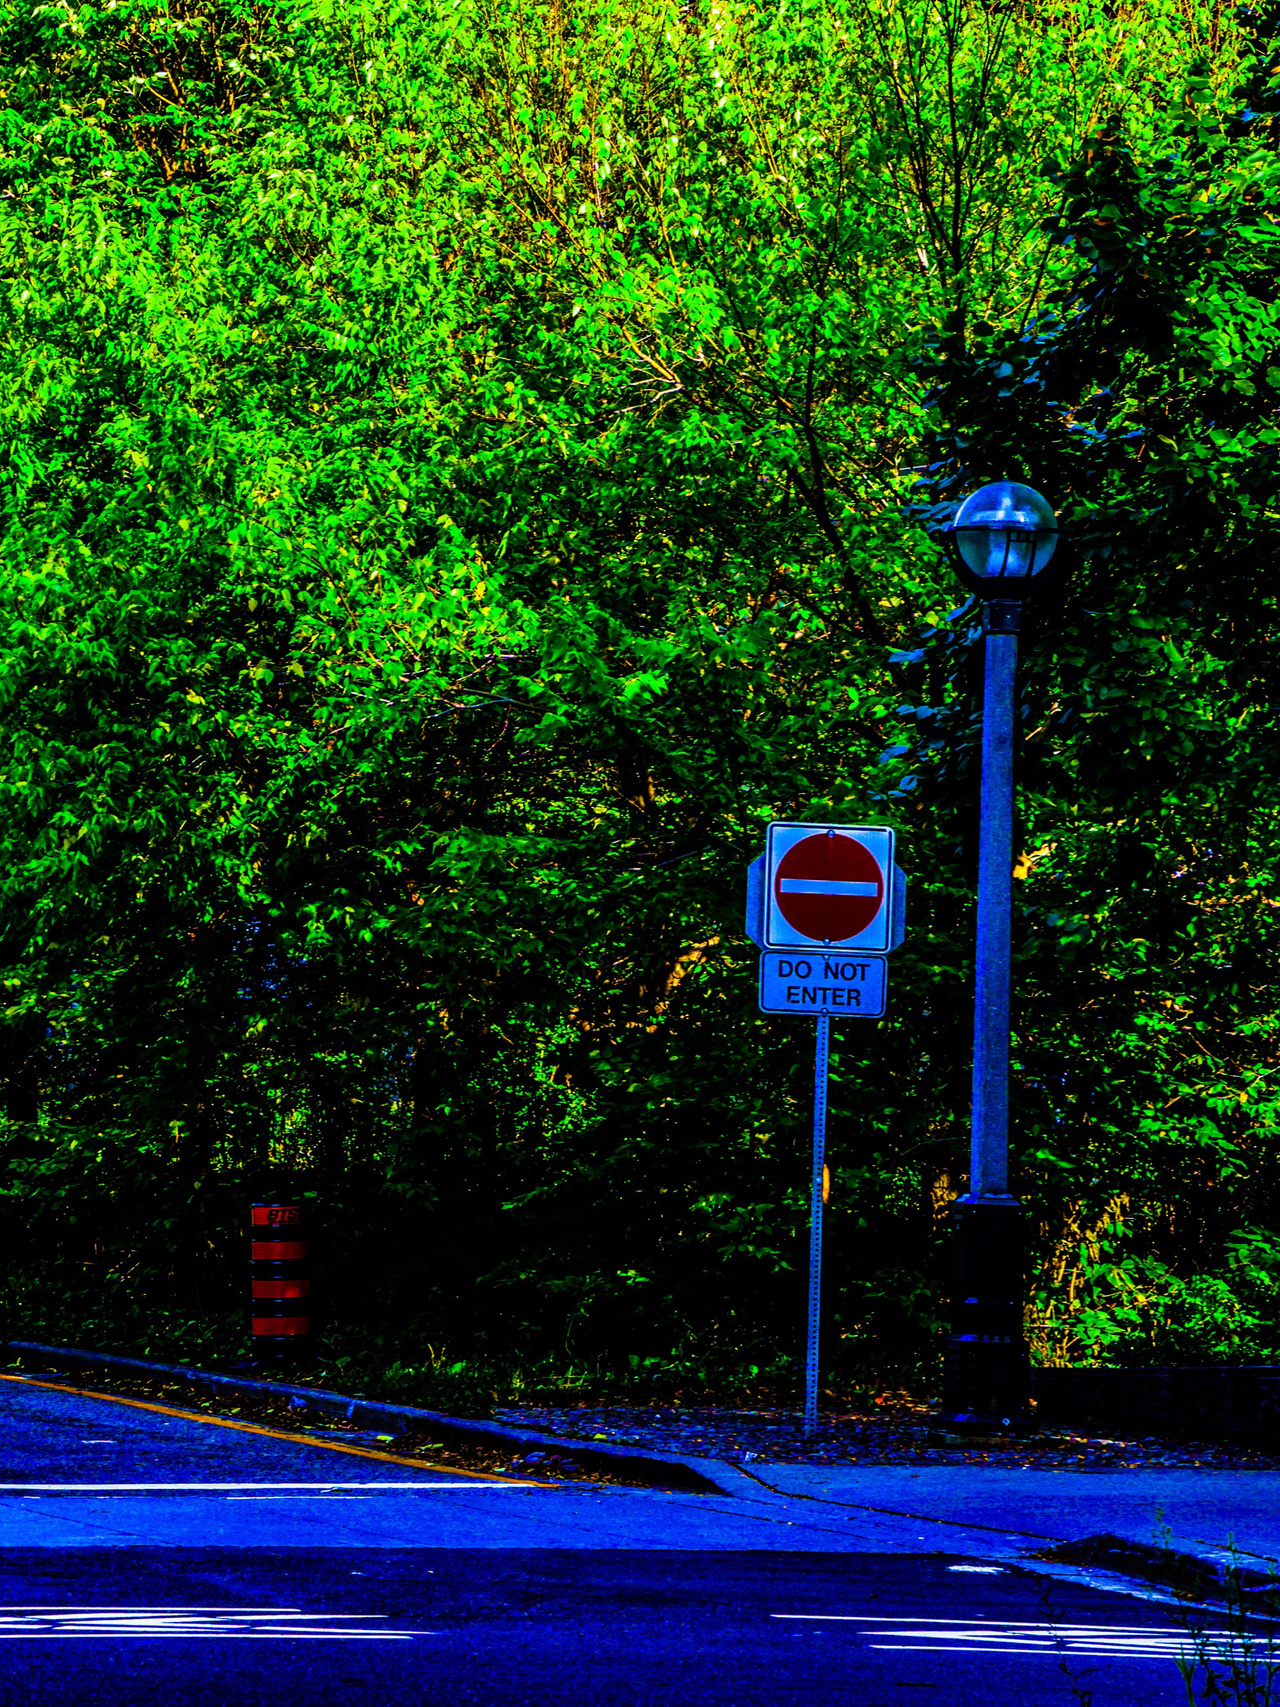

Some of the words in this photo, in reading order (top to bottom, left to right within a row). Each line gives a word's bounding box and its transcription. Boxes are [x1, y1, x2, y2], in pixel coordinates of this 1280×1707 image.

[778, 960, 812, 979] DO
[823, 962, 871, 981] NOT
[786, 985, 861, 1007] ENTER
